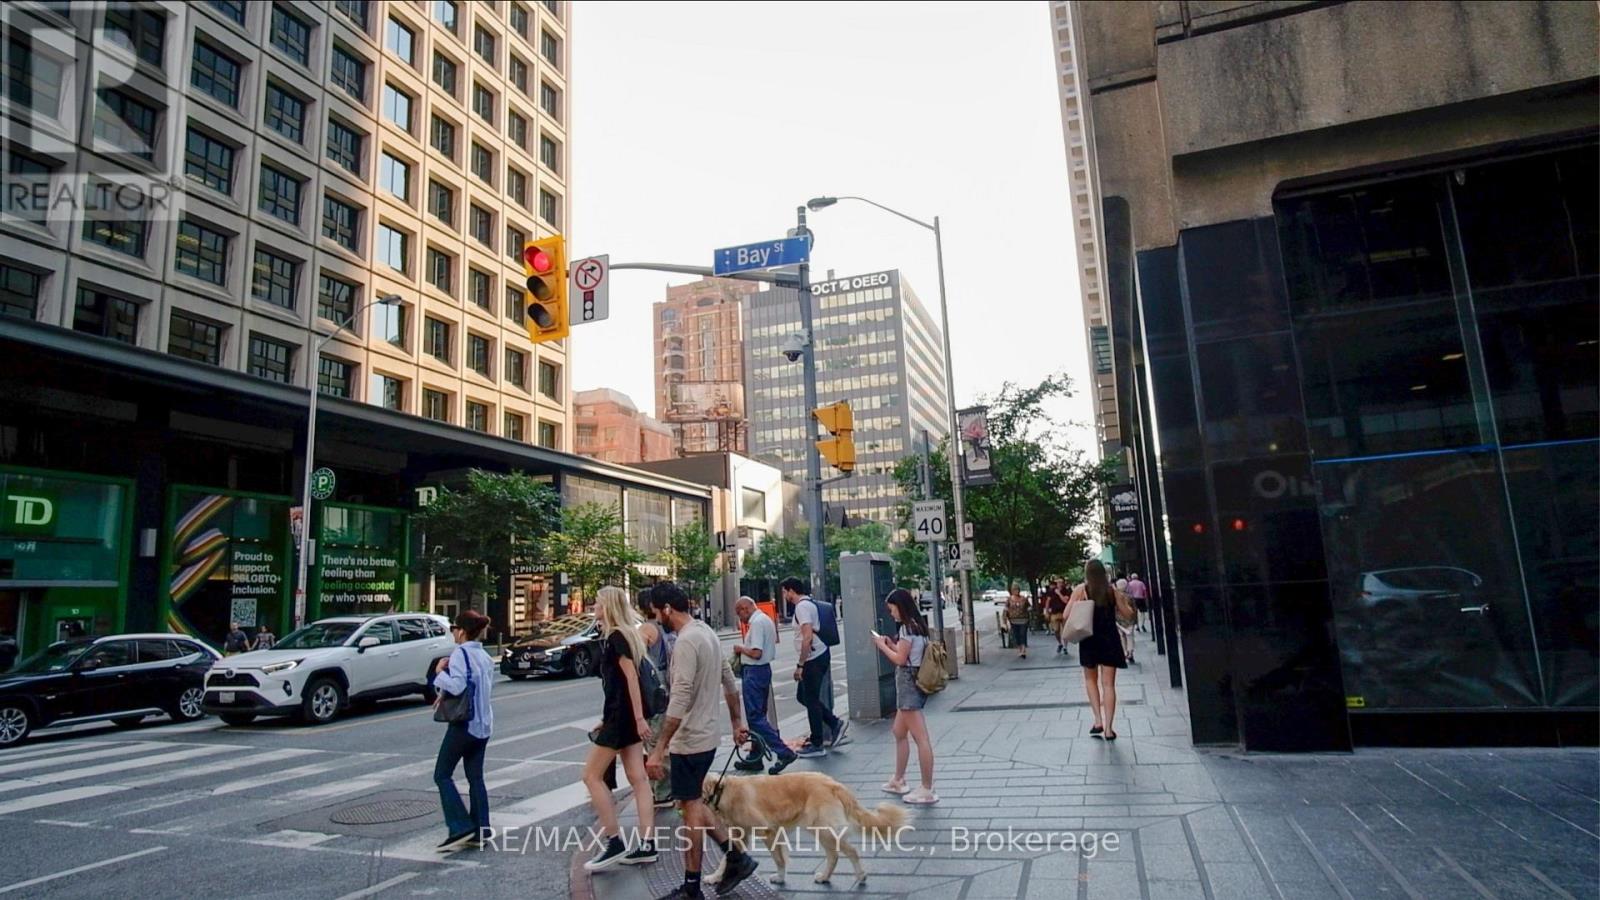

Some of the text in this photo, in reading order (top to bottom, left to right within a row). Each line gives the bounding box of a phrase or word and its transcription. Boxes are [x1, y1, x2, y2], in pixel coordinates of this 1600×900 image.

[737, 242, 784, 267] Bay St
[811, 273, 889, 296] OCT OEEO
[7, 494, 53, 526] TD
[916, 504, 942, 512] MAXIMUM
[917, 517, 943, 535] 40
[234, 551, 274, 562] Proud to
[322, 554, 396, 567] There's no better
[233, 564, 271, 573] support
[321, 567, 376, 580] feeling than
[232, 584, 278, 595] inclusion.
[354, 580, 396, 592] accepted
[320, 592, 392, 605] for who you are.
